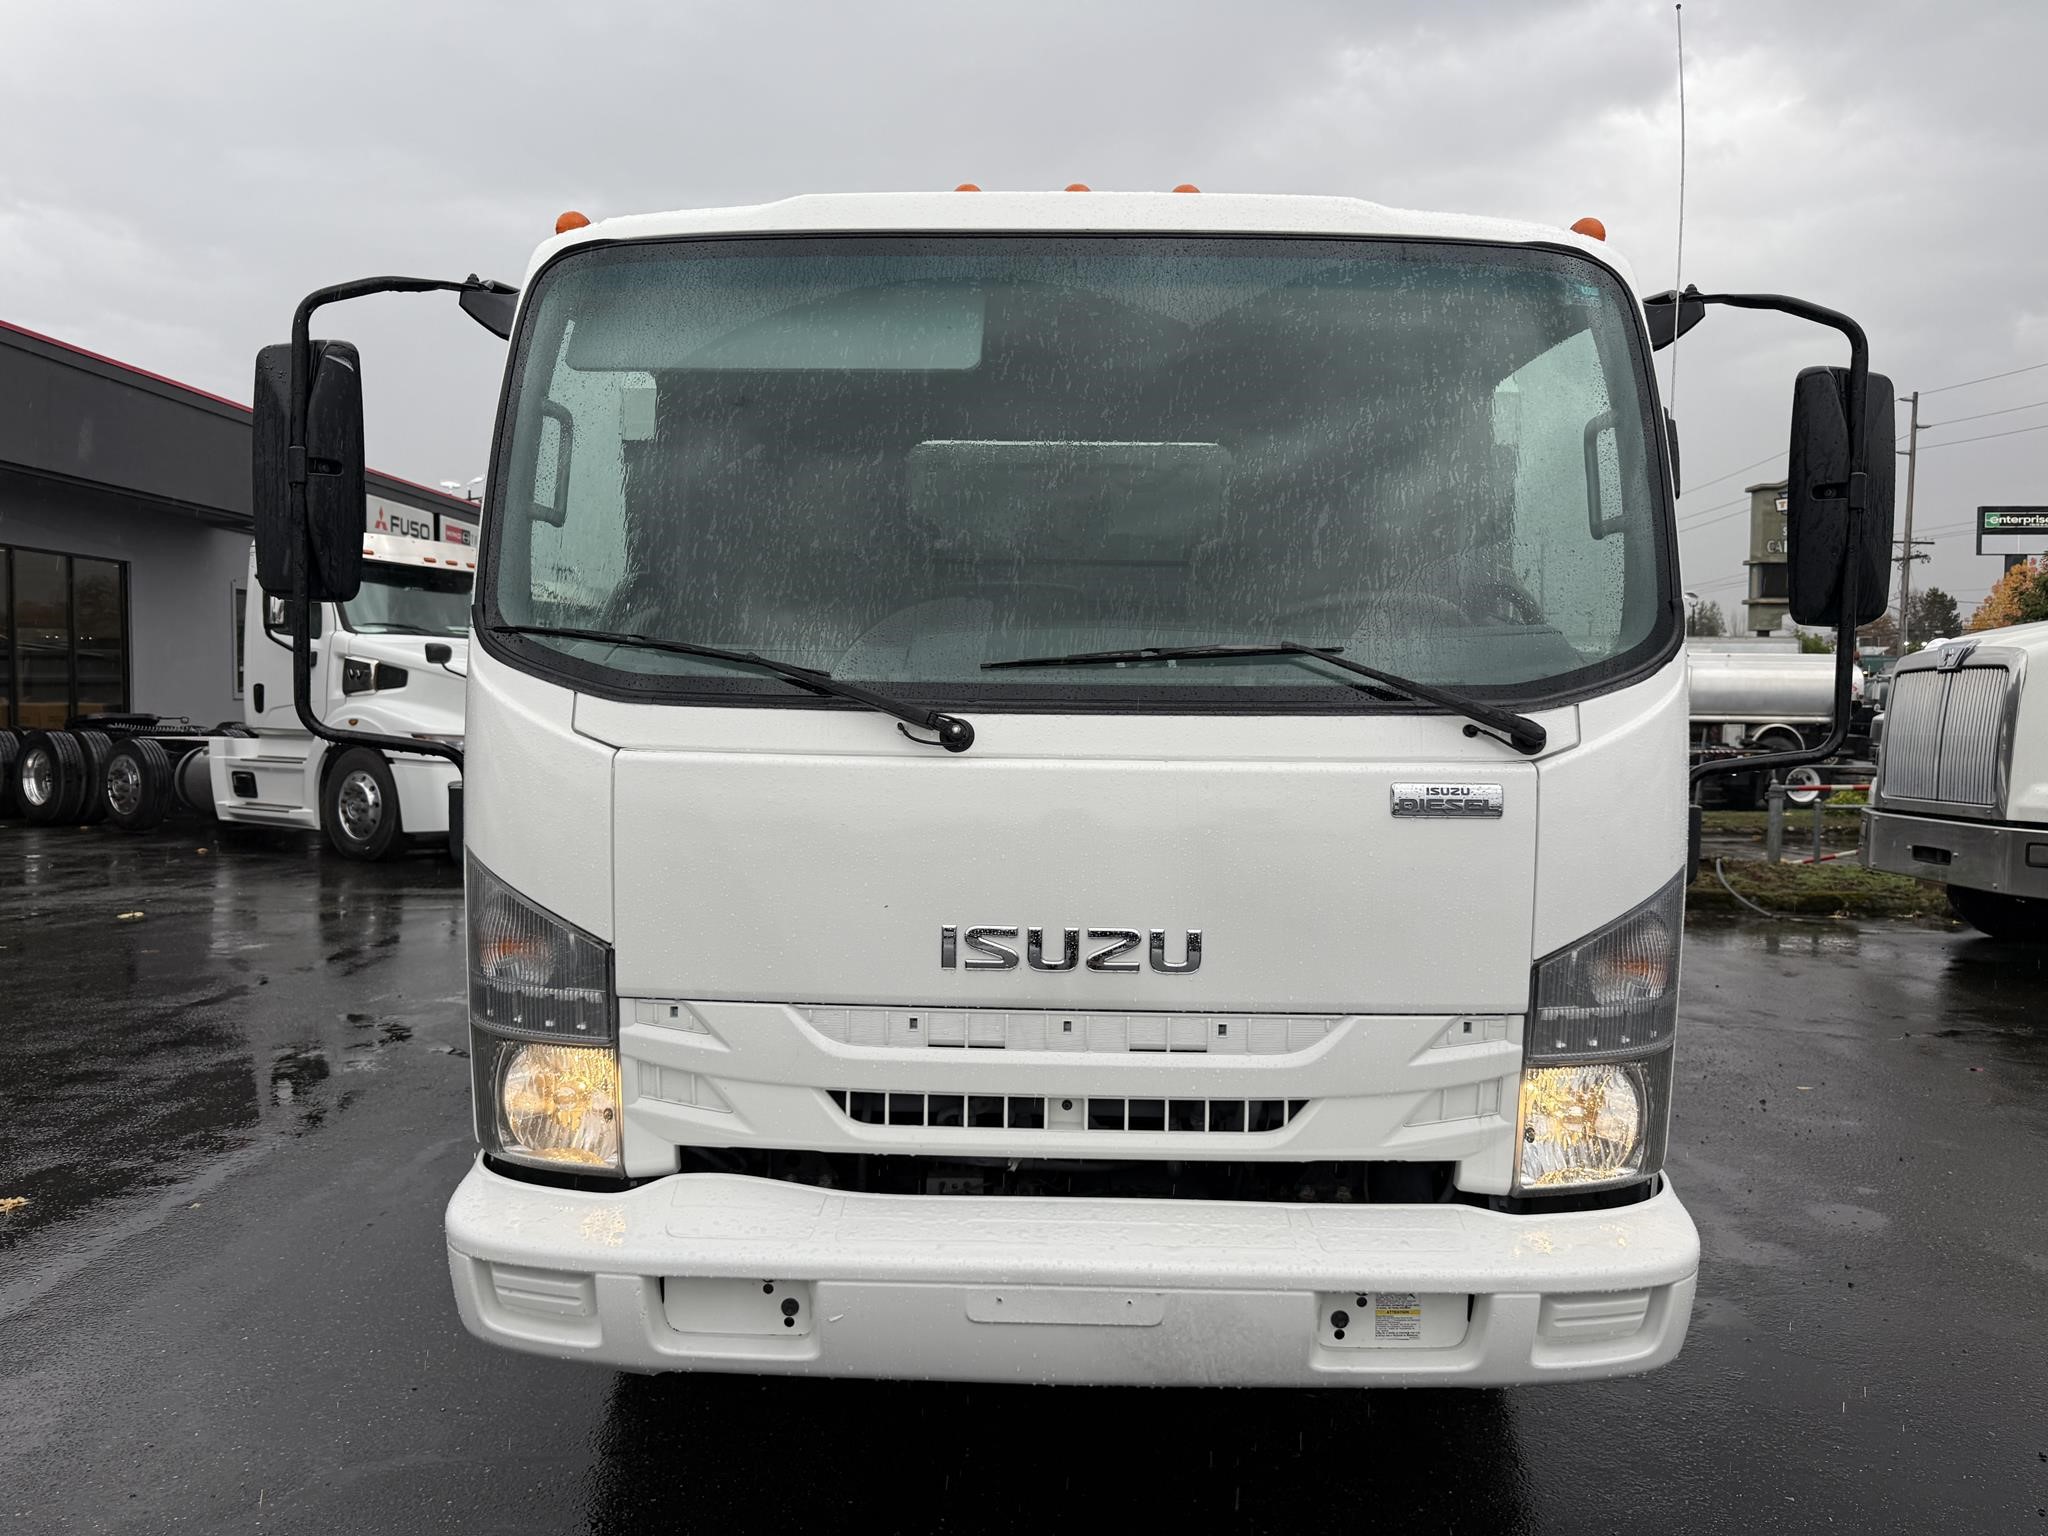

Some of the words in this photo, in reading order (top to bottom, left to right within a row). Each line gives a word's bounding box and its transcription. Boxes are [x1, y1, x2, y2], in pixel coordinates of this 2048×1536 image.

[390, 515, 430, 540] FUSO
[1426, 787, 1470, 796] ISUZU
[1397, 798, 1502, 815] DIESEL
[941, 924, 1202, 974] ISUZU
